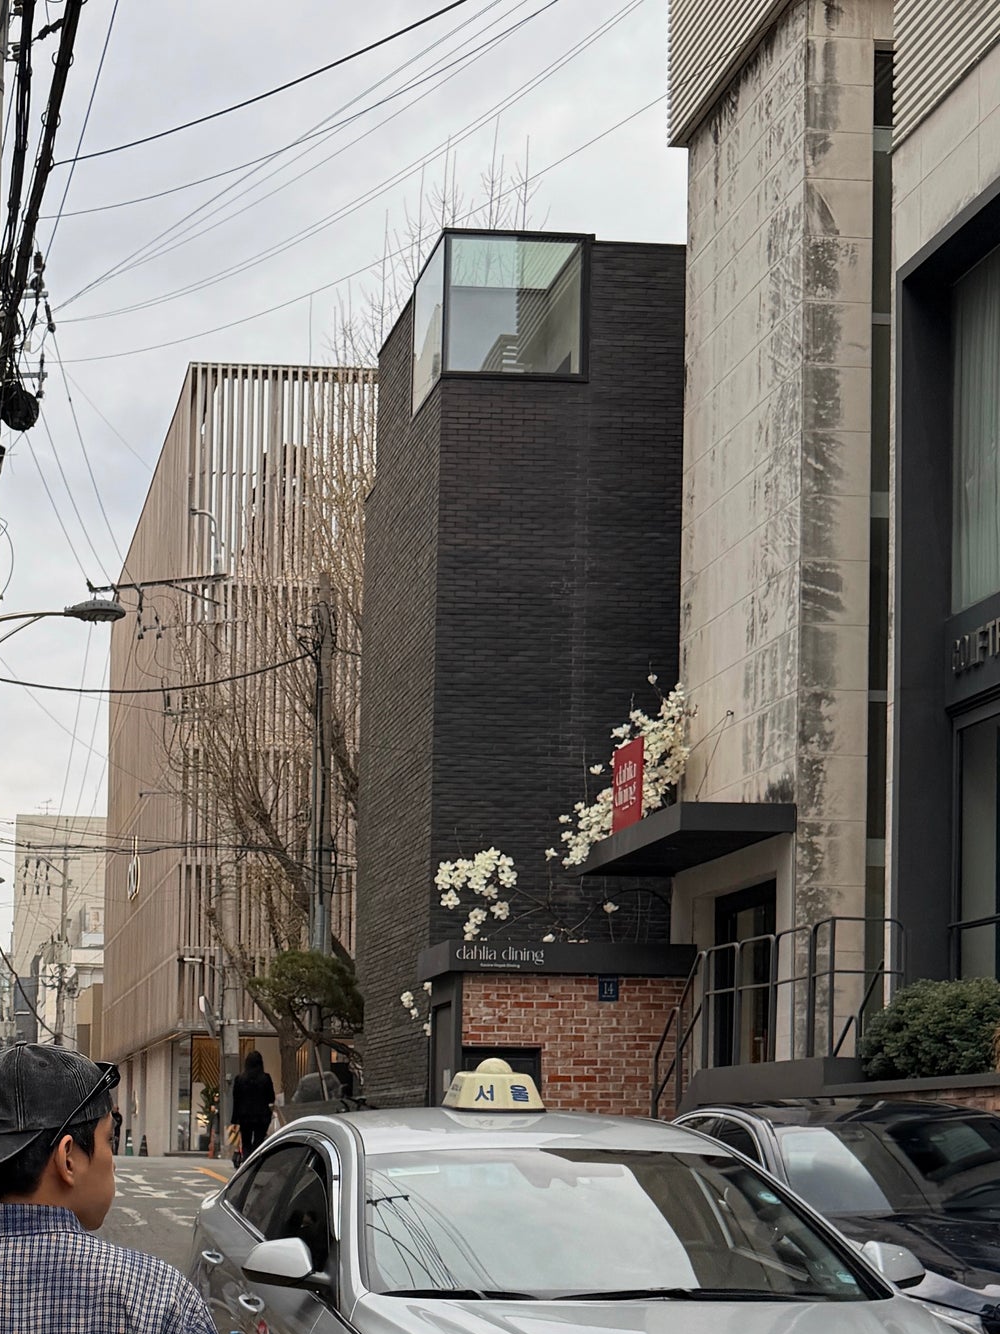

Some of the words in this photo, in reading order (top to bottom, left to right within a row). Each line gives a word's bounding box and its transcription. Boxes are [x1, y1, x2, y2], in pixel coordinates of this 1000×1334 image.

[456, 945, 497, 961] dahlia
[502, 946, 545, 966] dining
[603, 982, 614, 995] 14
[475, 1084, 530, 1102] 서울
